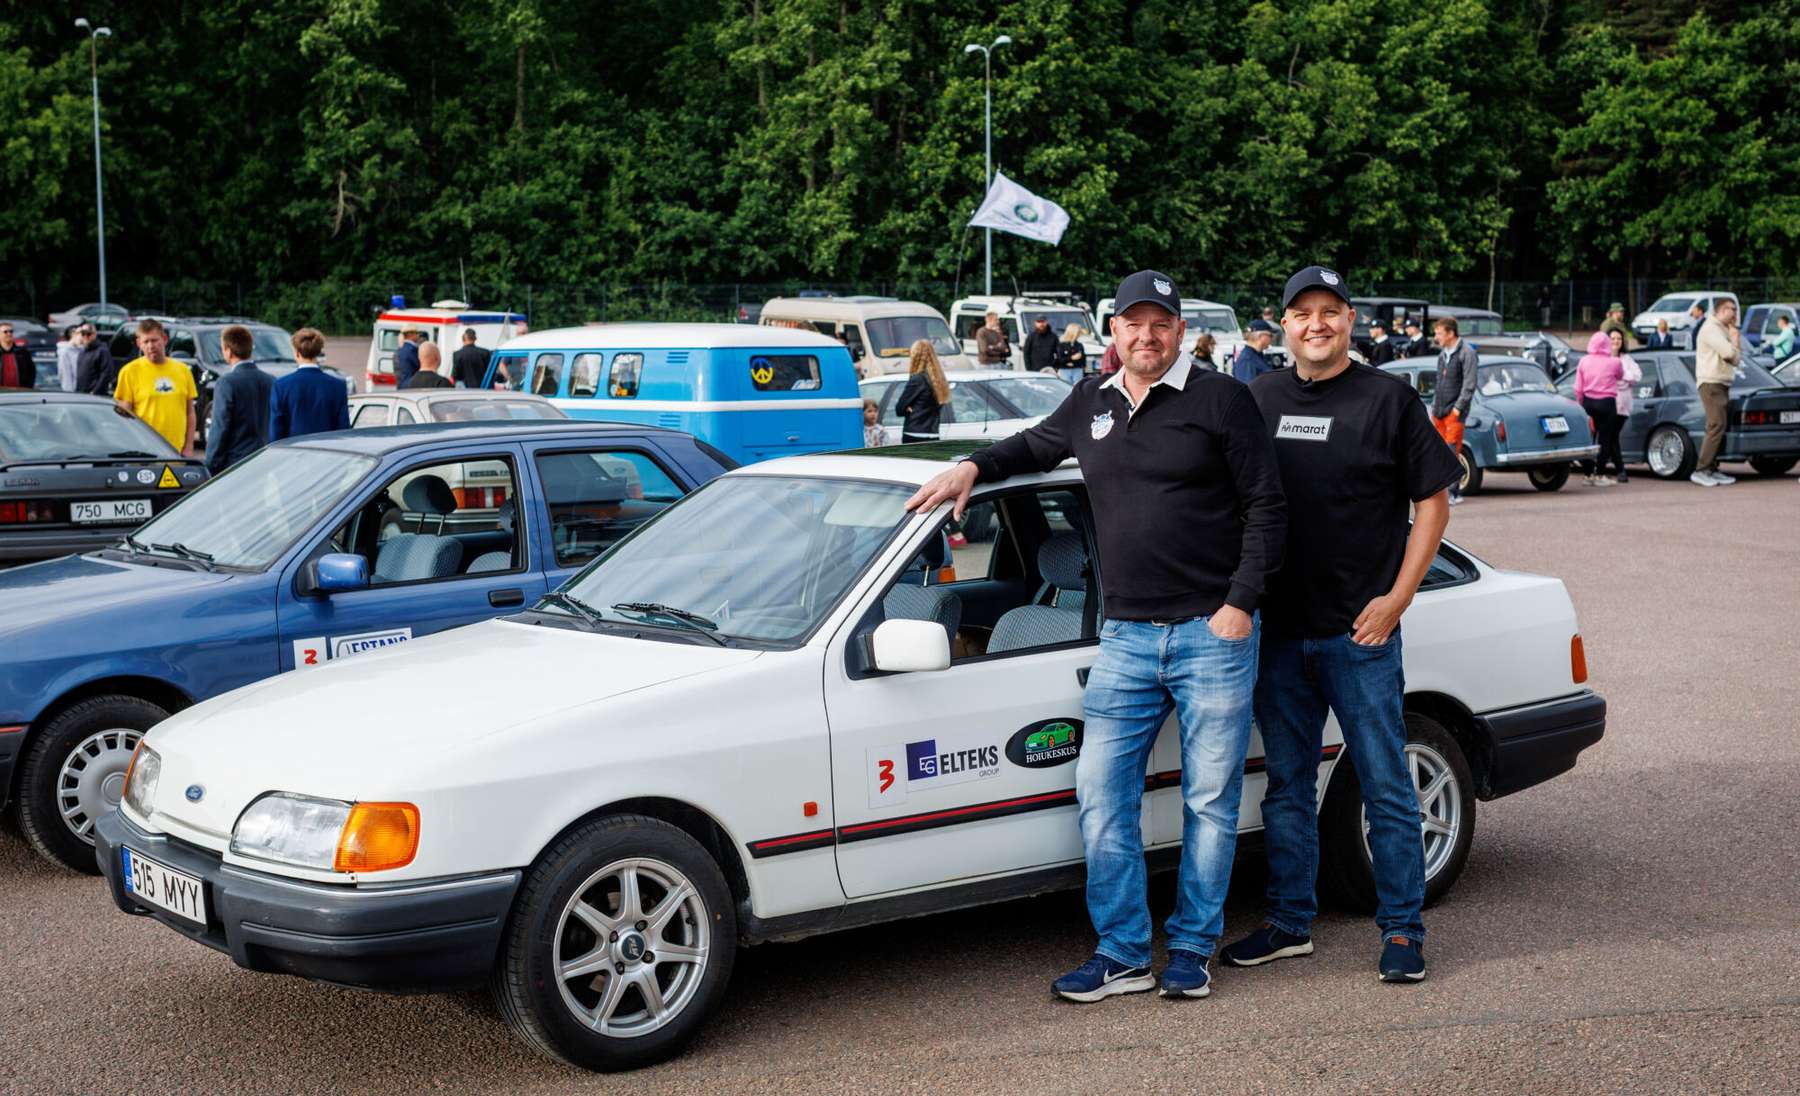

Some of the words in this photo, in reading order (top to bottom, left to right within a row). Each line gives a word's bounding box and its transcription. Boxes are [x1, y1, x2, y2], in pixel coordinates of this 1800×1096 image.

[1291, 424, 1327, 435] marat
[76, 504, 102, 519] 750
[114, 502, 145, 517] MCG
[940, 745, 999, 775] ELTEKS
[1026, 746, 1077, 764] HOIUKESKUS
[878, 759, 896, 794] 3
[979, 767, 1000, 777] GROUP
[132, 859, 155, 897] 515
[162, 872, 198, 918] MYY
